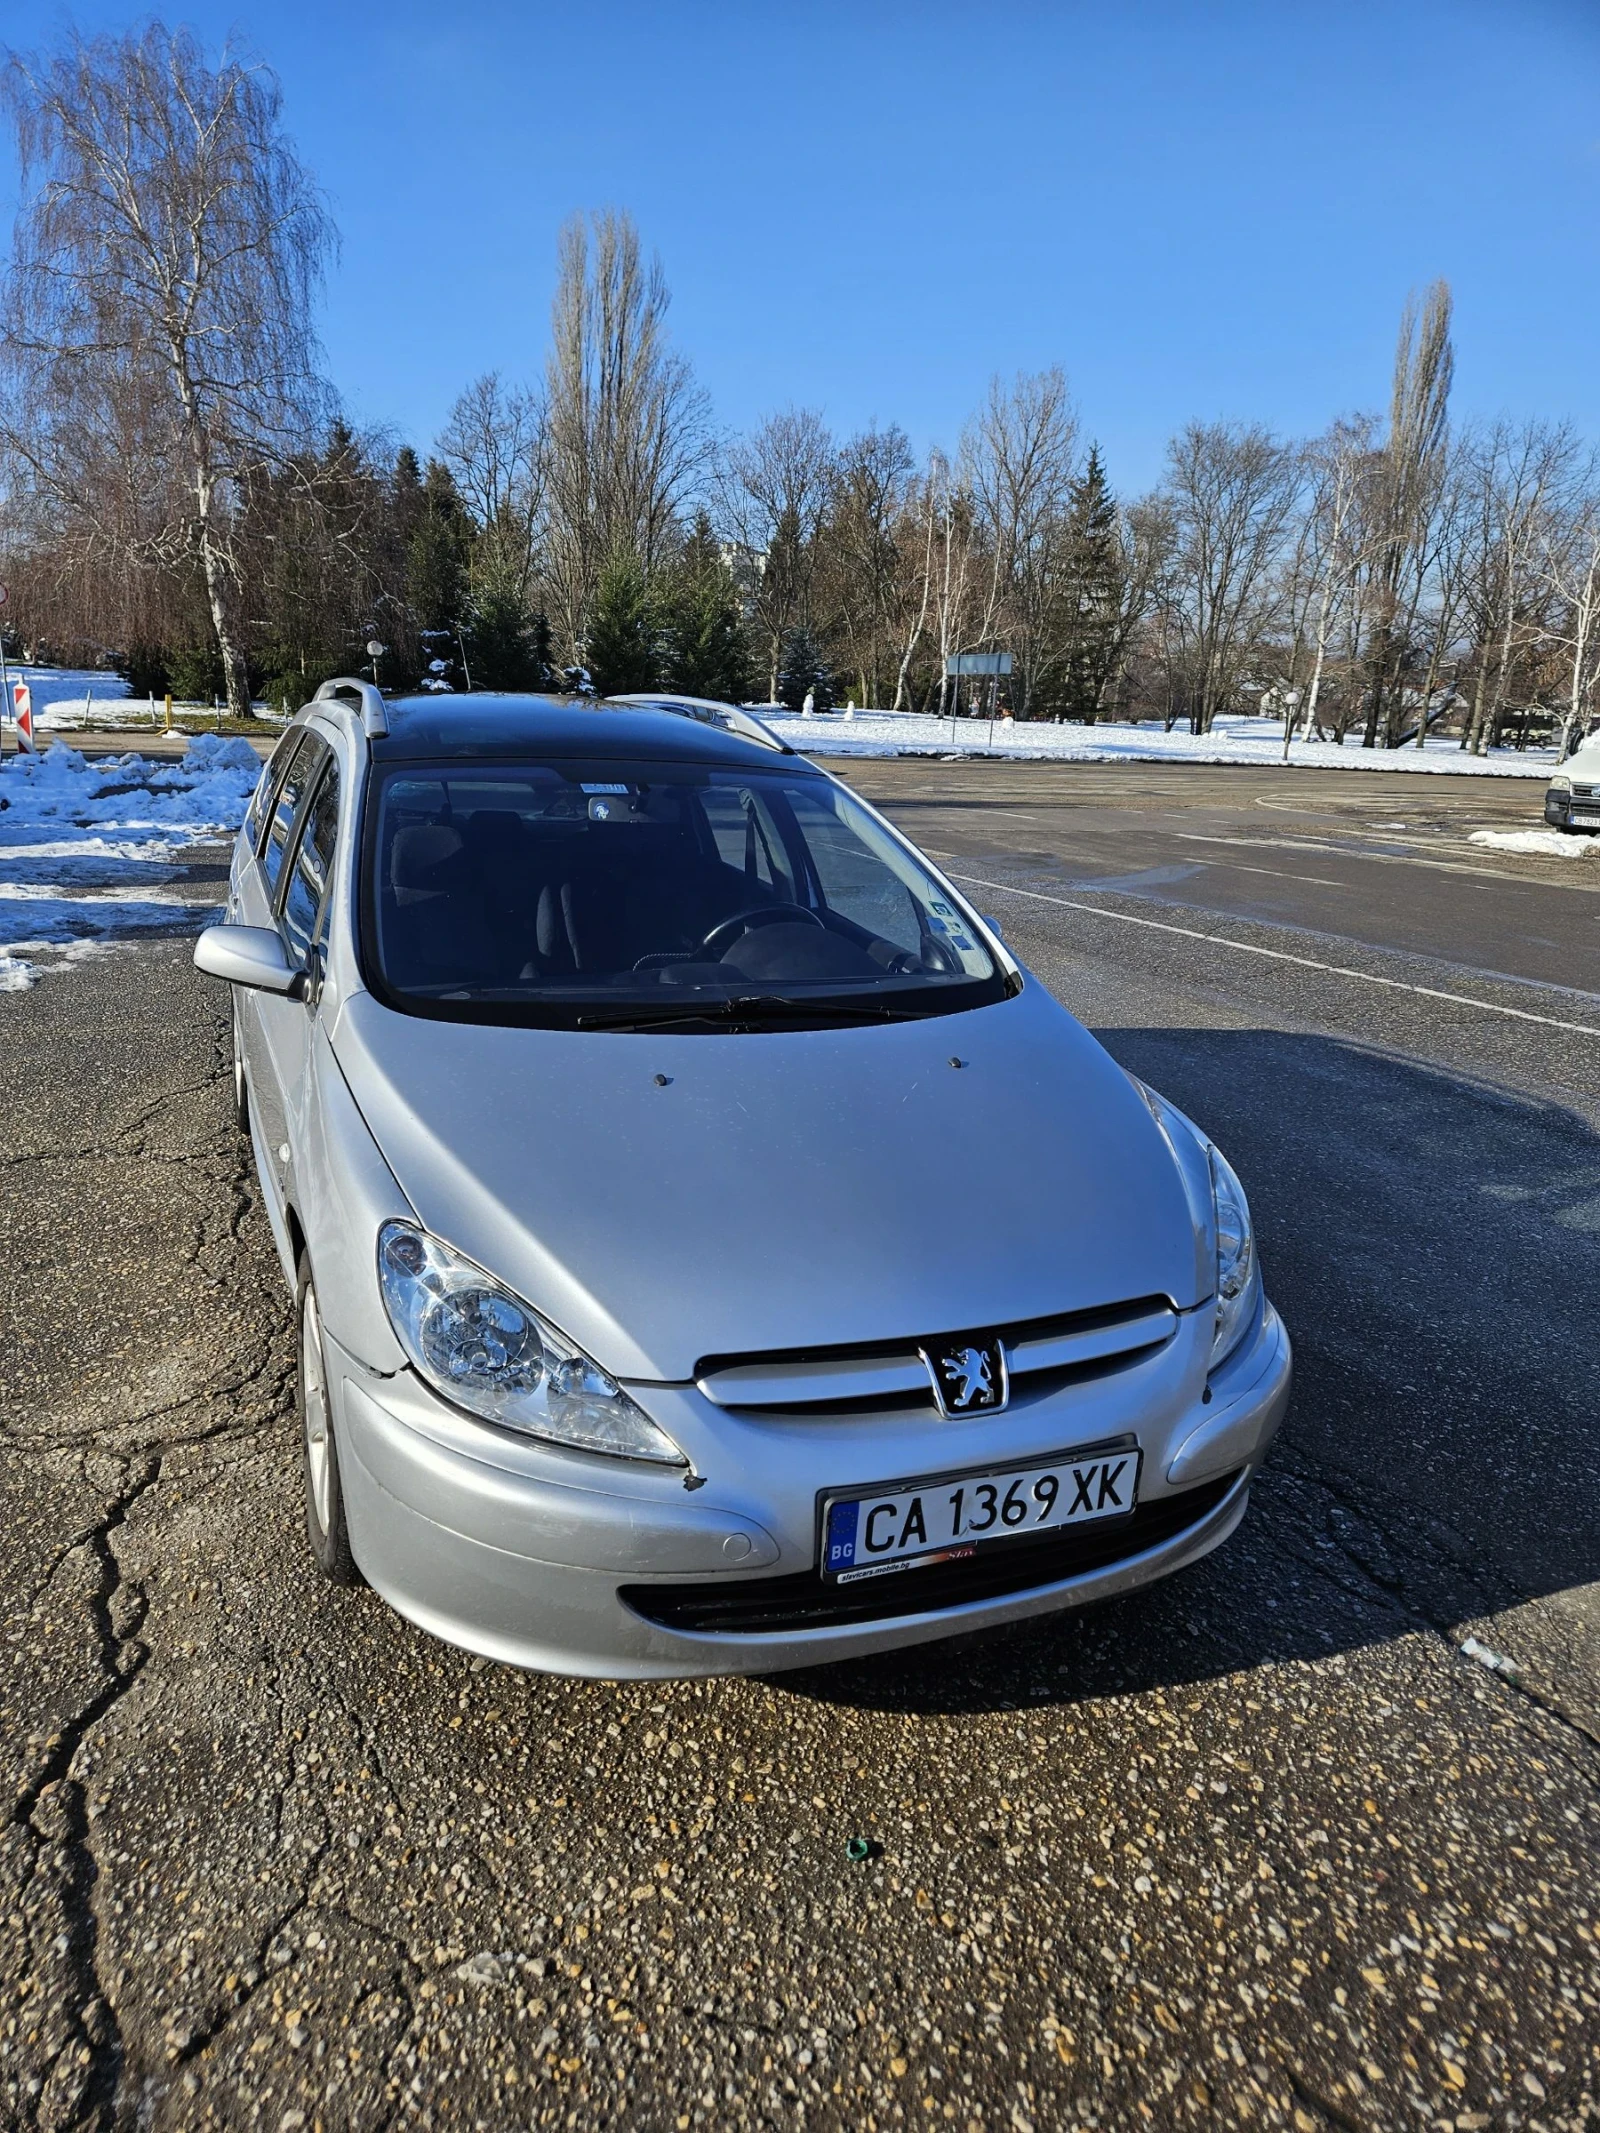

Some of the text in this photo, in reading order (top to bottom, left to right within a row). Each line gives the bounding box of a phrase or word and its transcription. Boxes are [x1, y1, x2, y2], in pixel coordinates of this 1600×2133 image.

[864, 1460, 1128, 1553] CA 1369 XK
[831, 1544, 853, 1560] BG
[841, 1562, 911, 1582] slavicars.mobile.bg
